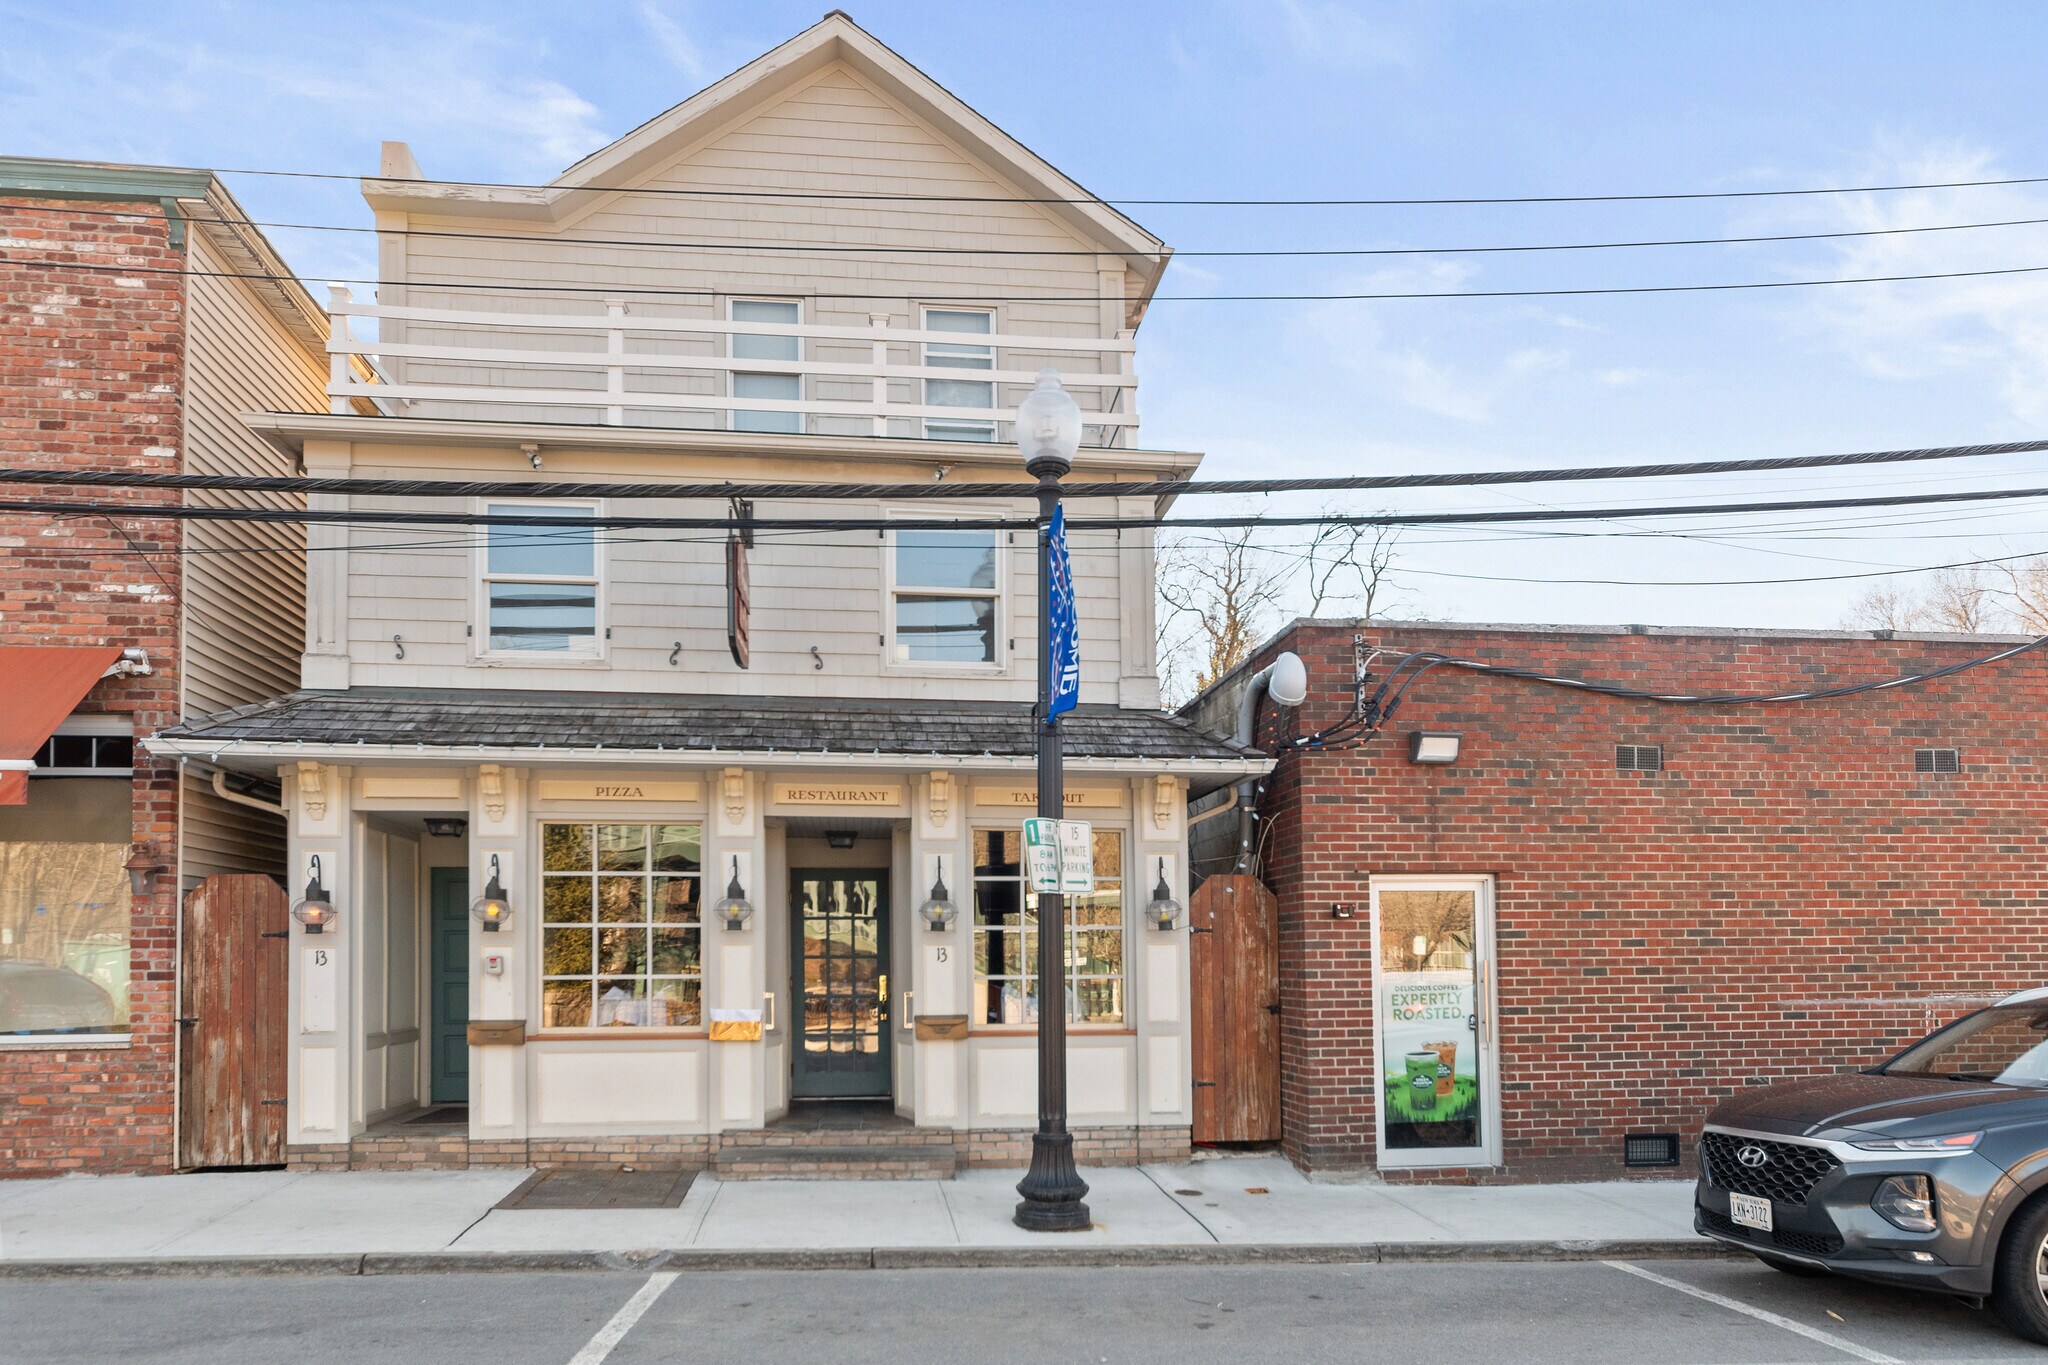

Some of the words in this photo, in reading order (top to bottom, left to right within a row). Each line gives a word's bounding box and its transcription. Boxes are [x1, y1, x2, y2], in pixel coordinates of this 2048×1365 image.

[595, 786, 644, 798] PIZZA
[787, 789, 889, 802] RESTAURANT
[1011, 792, 1039, 803] TAK
[1028, 823, 1036, 843] 1
[1071, 826, 1079, 841] 15
[1063, 845, 1087, 858] MINUTE
[1061, 861, 1090, 874] PARKING
[315, 950, 328, 967] 13
[936, 947, 948, 963] 13
[1391, 992, 1462, 1006] EXPERTLY
[1393, 1007, 1466, 1021] ROASTED.
